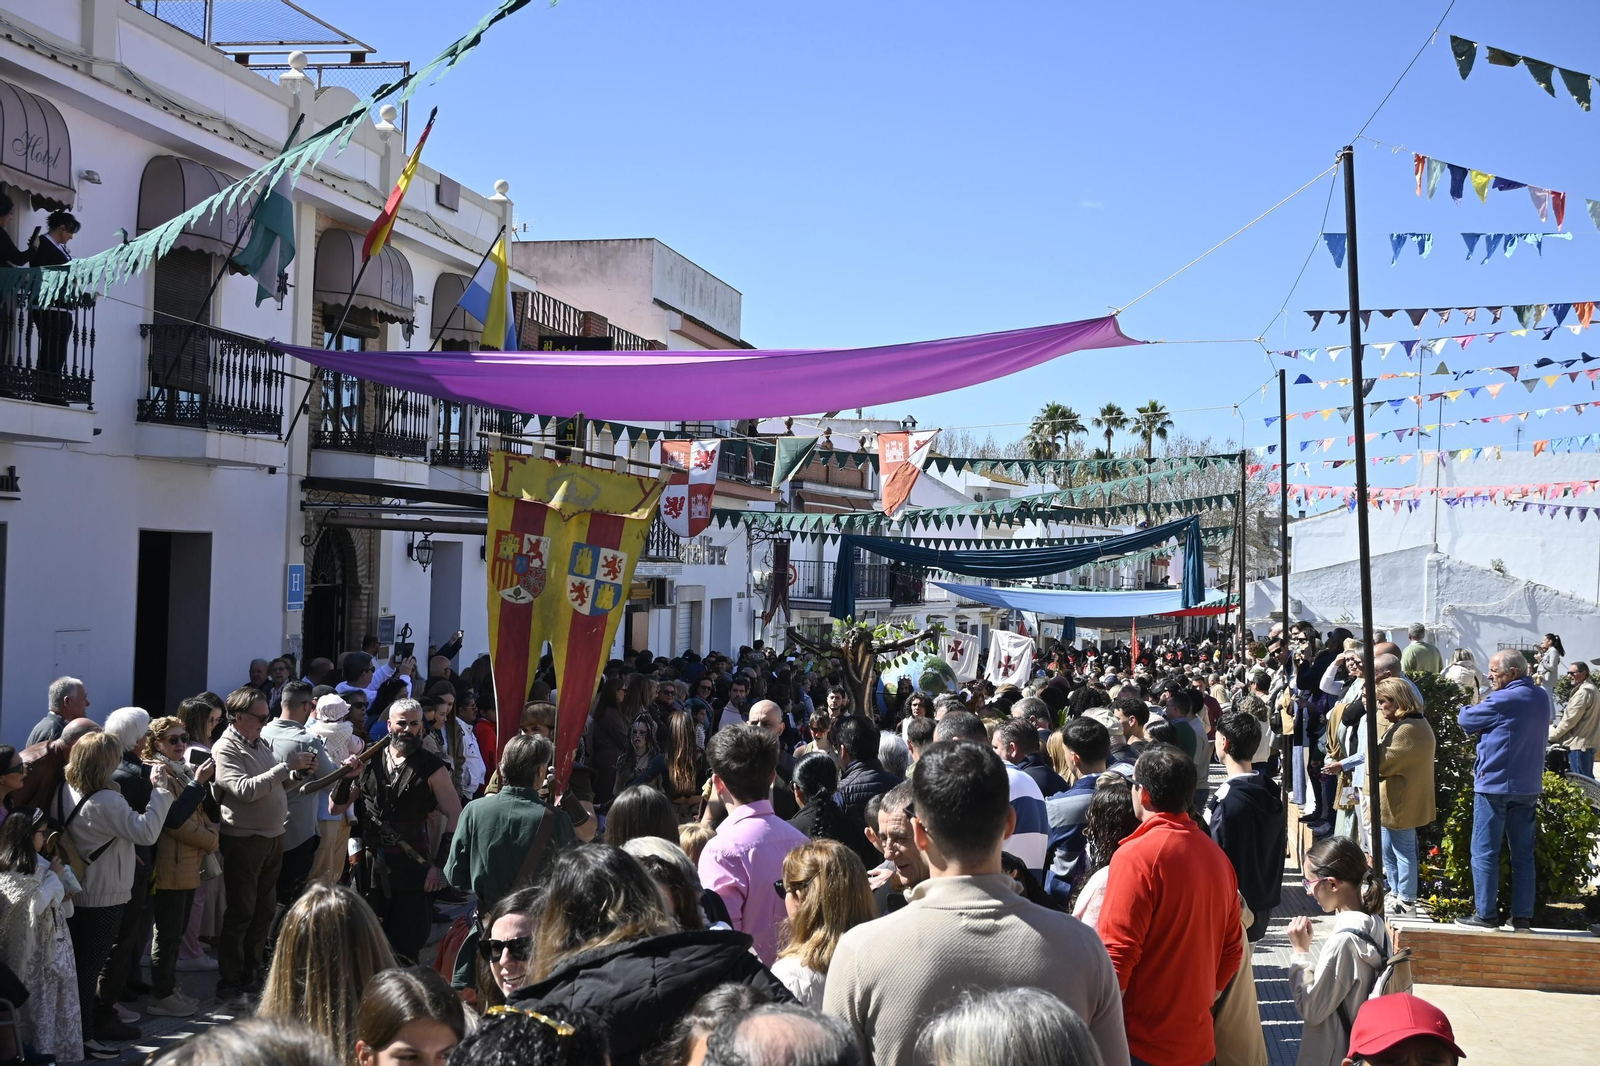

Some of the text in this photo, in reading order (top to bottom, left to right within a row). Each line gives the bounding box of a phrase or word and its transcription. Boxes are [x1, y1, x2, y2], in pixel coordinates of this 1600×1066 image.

[12, 131, 61, 169] Hotel
[542, 340, 578, 351] Htl
[501, 456, 658, 512] F Y
[291, 573, 301, 591] H
